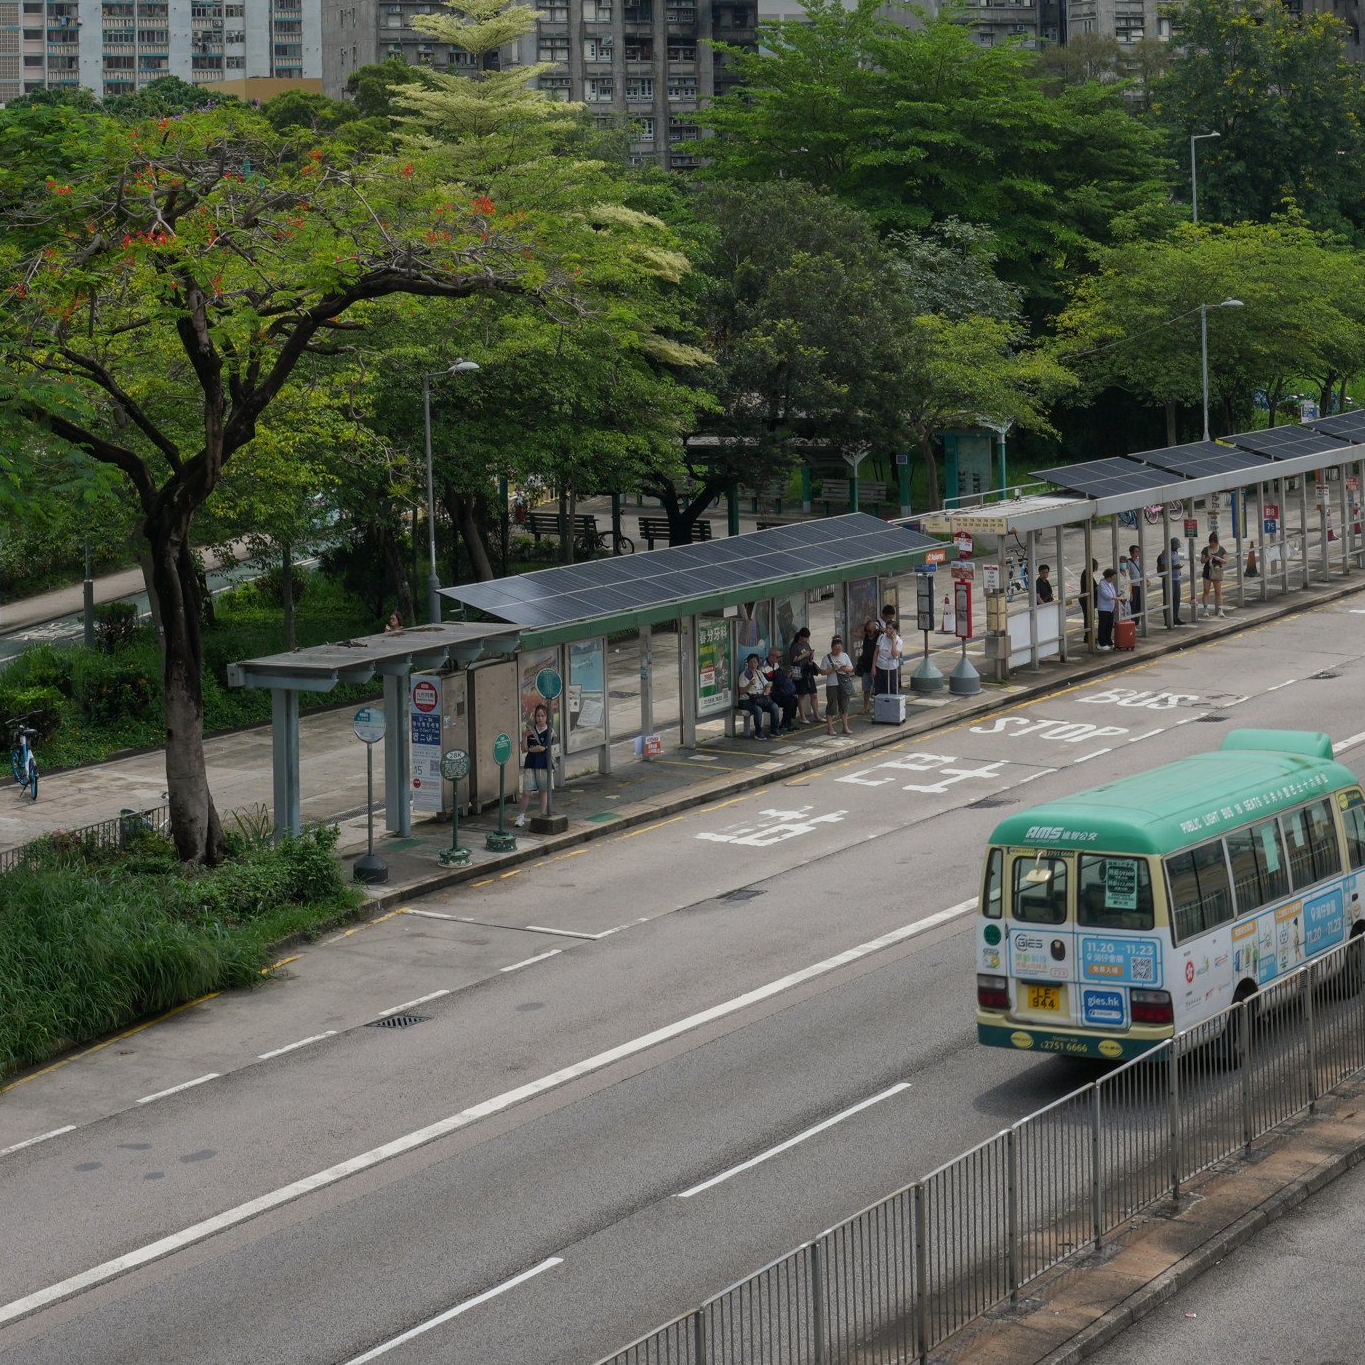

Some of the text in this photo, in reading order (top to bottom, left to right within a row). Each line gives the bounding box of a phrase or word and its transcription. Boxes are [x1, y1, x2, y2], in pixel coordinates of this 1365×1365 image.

[1076, 687, 1200, 710] BUS
[968, 716, 1130, 743] STOP
[834, 752, 1013, 794] 巴士
[1025, 826, 1064, 839] AMS
[1087, 942, 1153, 955] 11.20 11.23
[1033, 998, 1055, 1008] 944
[1087, 995, 1120, 1006] gies.hk
[1043, 1040, 1088, 1053] 2751 6666
